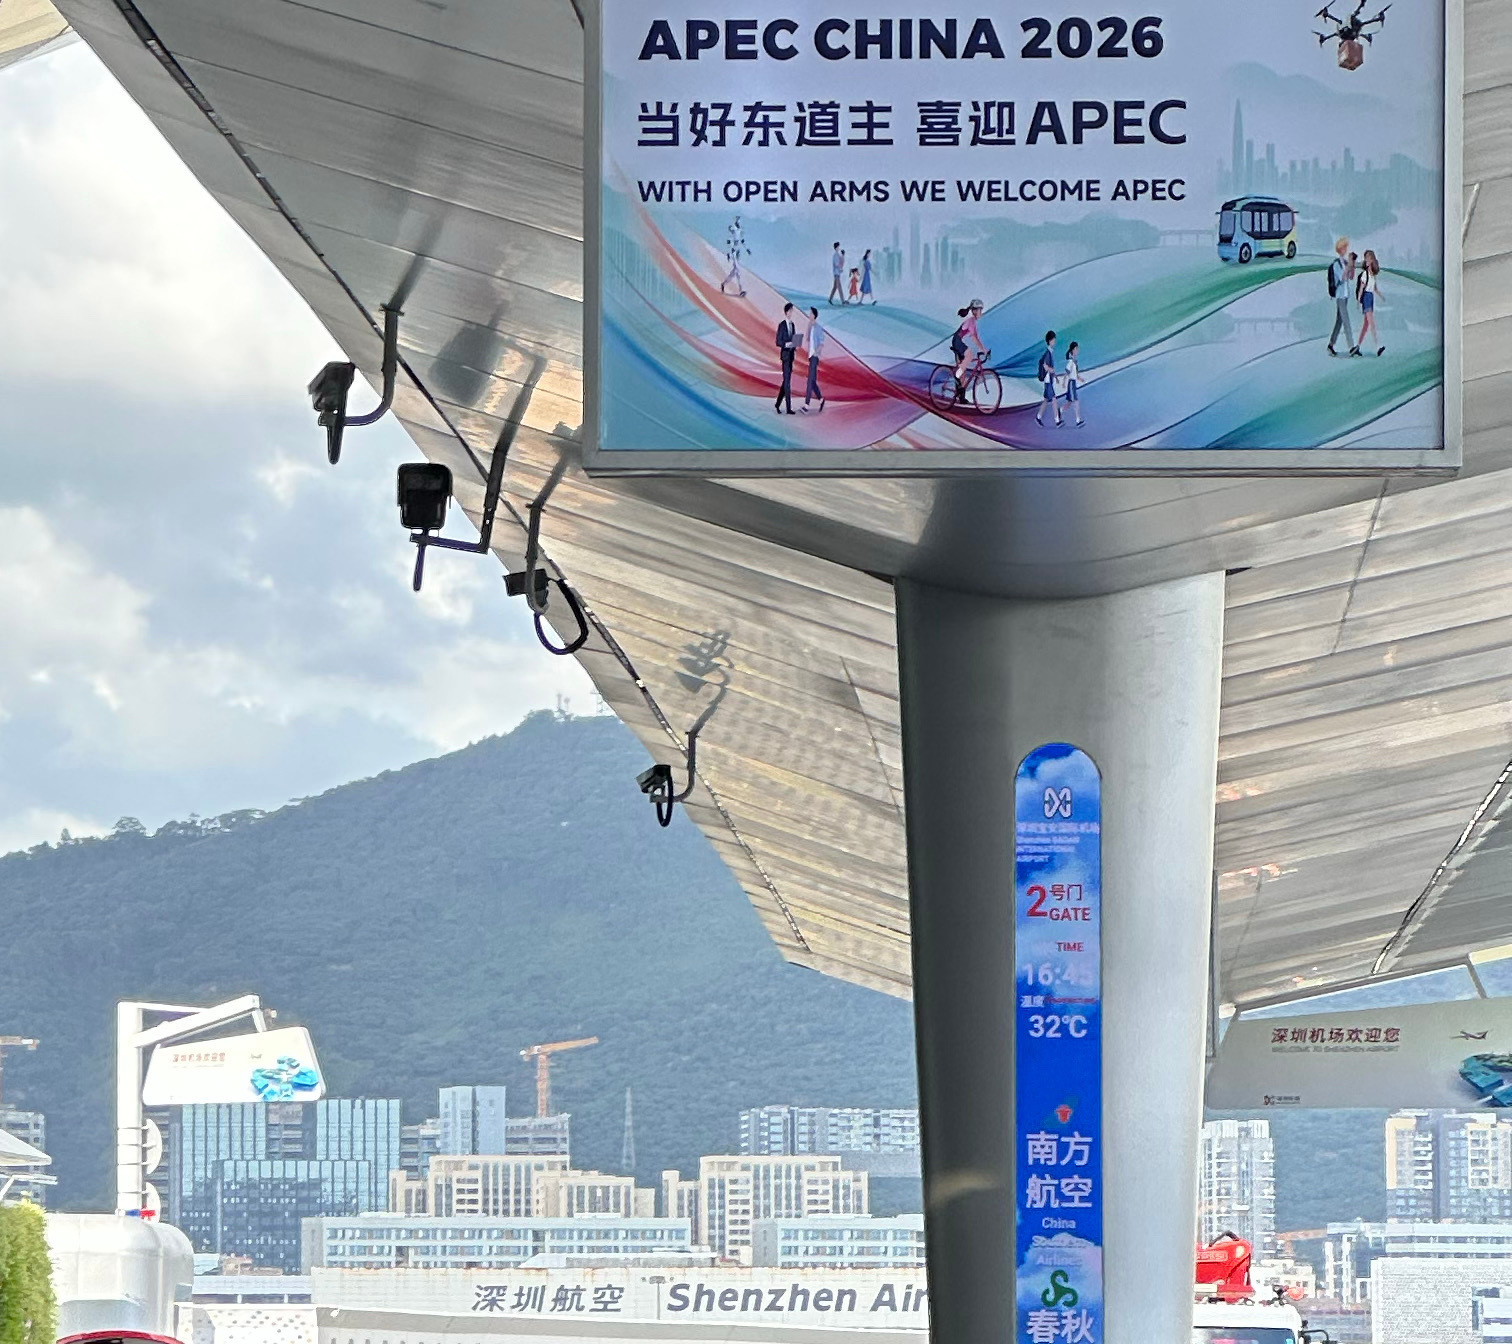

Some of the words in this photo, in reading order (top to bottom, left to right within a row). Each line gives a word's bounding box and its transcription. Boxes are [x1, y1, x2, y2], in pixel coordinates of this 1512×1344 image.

[638, 18, 799, 60] APEC
[814, 17, 1005, 60] CHINA
[1020, 16, 1164, 59] 2026
[638, 100, 894, 147] 当好东道主
[637, 180, 712, 202] WITH
[723, 180, 798, 202] OPEN
[809, 180, 890, 202] ARMS
[900, 180, 945, 202] WE
[956, 179, 1101, 202] WELCOME
[1111, 179, 1186, 201] APEC
[1049, 907, 1092, 921] GATE
[1056, 941, 1084, 952] TIME
[1271, 1027, 1401, 1044] 深圳机场欢迎您
[1026, 1131, 1093, 1167] 南方
[1026, 1174, 1093, 1208] 航空
[1042, 1217, 1077, 1229] China
[471, 1284, 625, 1313] 深圳航空
[666, 1283, 857, 1312] Shenzhen
[1026, 1309, 1095, 1344] 春秋
